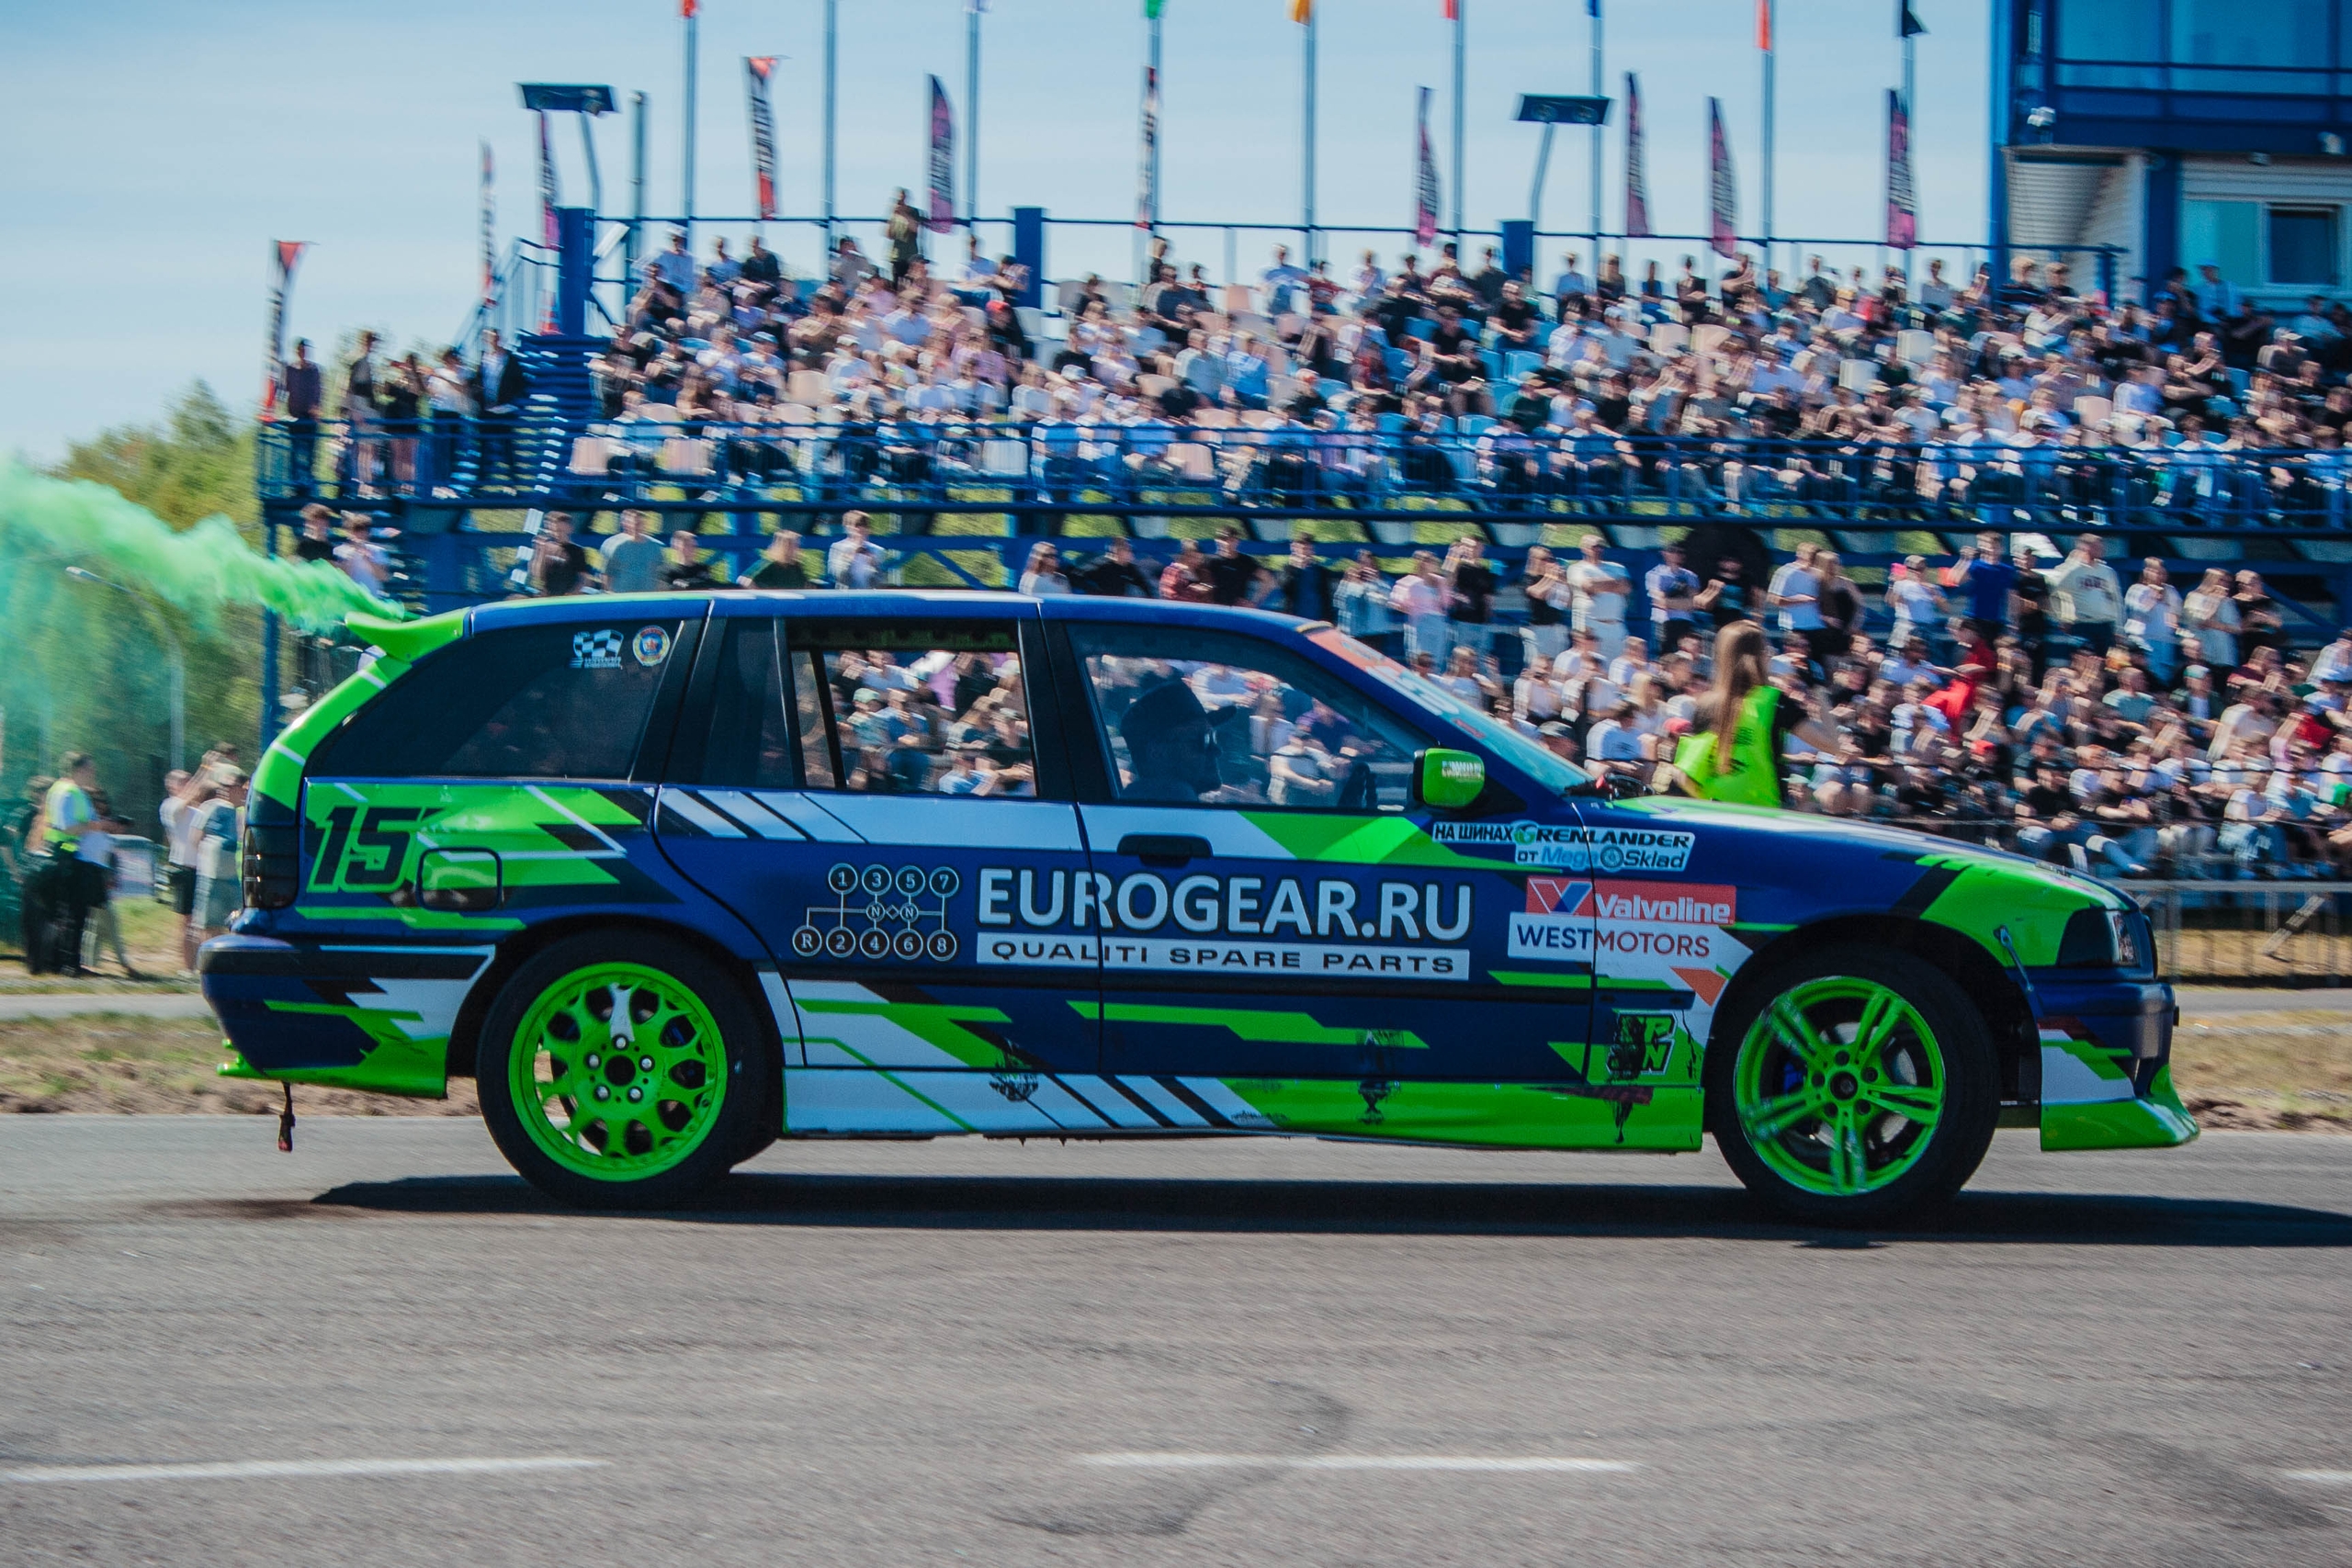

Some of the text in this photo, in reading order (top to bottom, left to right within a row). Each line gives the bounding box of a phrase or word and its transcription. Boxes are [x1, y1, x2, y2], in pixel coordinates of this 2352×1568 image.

[309, 805, 424, 887] 15
[1435, 826, 1513, 841] НА ШИНАХ
[978, 868, 1470, 941] EUROGEAR.RU
[1595, 894, 1731, 923] Valvoline
[991, 942, 1454, 974] QUALITI SPARE PARTS
